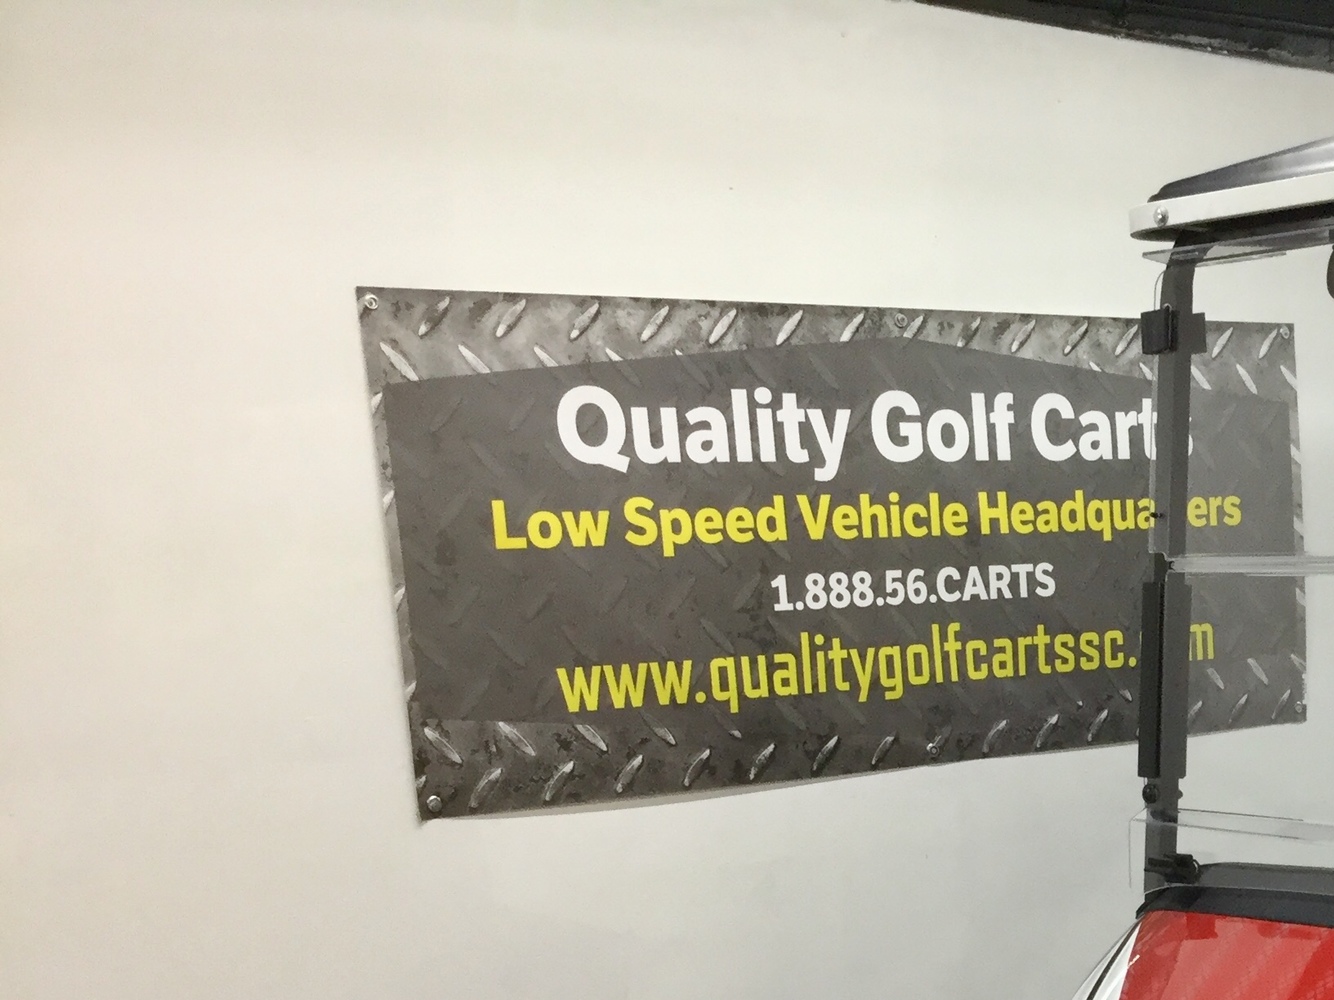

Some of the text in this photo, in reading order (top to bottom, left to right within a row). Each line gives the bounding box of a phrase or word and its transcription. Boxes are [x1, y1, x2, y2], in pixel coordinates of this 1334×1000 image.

[556, 384, 1194, 482] Quality Golf Cart
[490, 487, 1242, 559] Low Speed Vehicle Headquaers
[771, 562, 1056, 613] 1.888.56.CARTS
[556, 620, 1215, 714] www.qualitygolfcartssc.m
